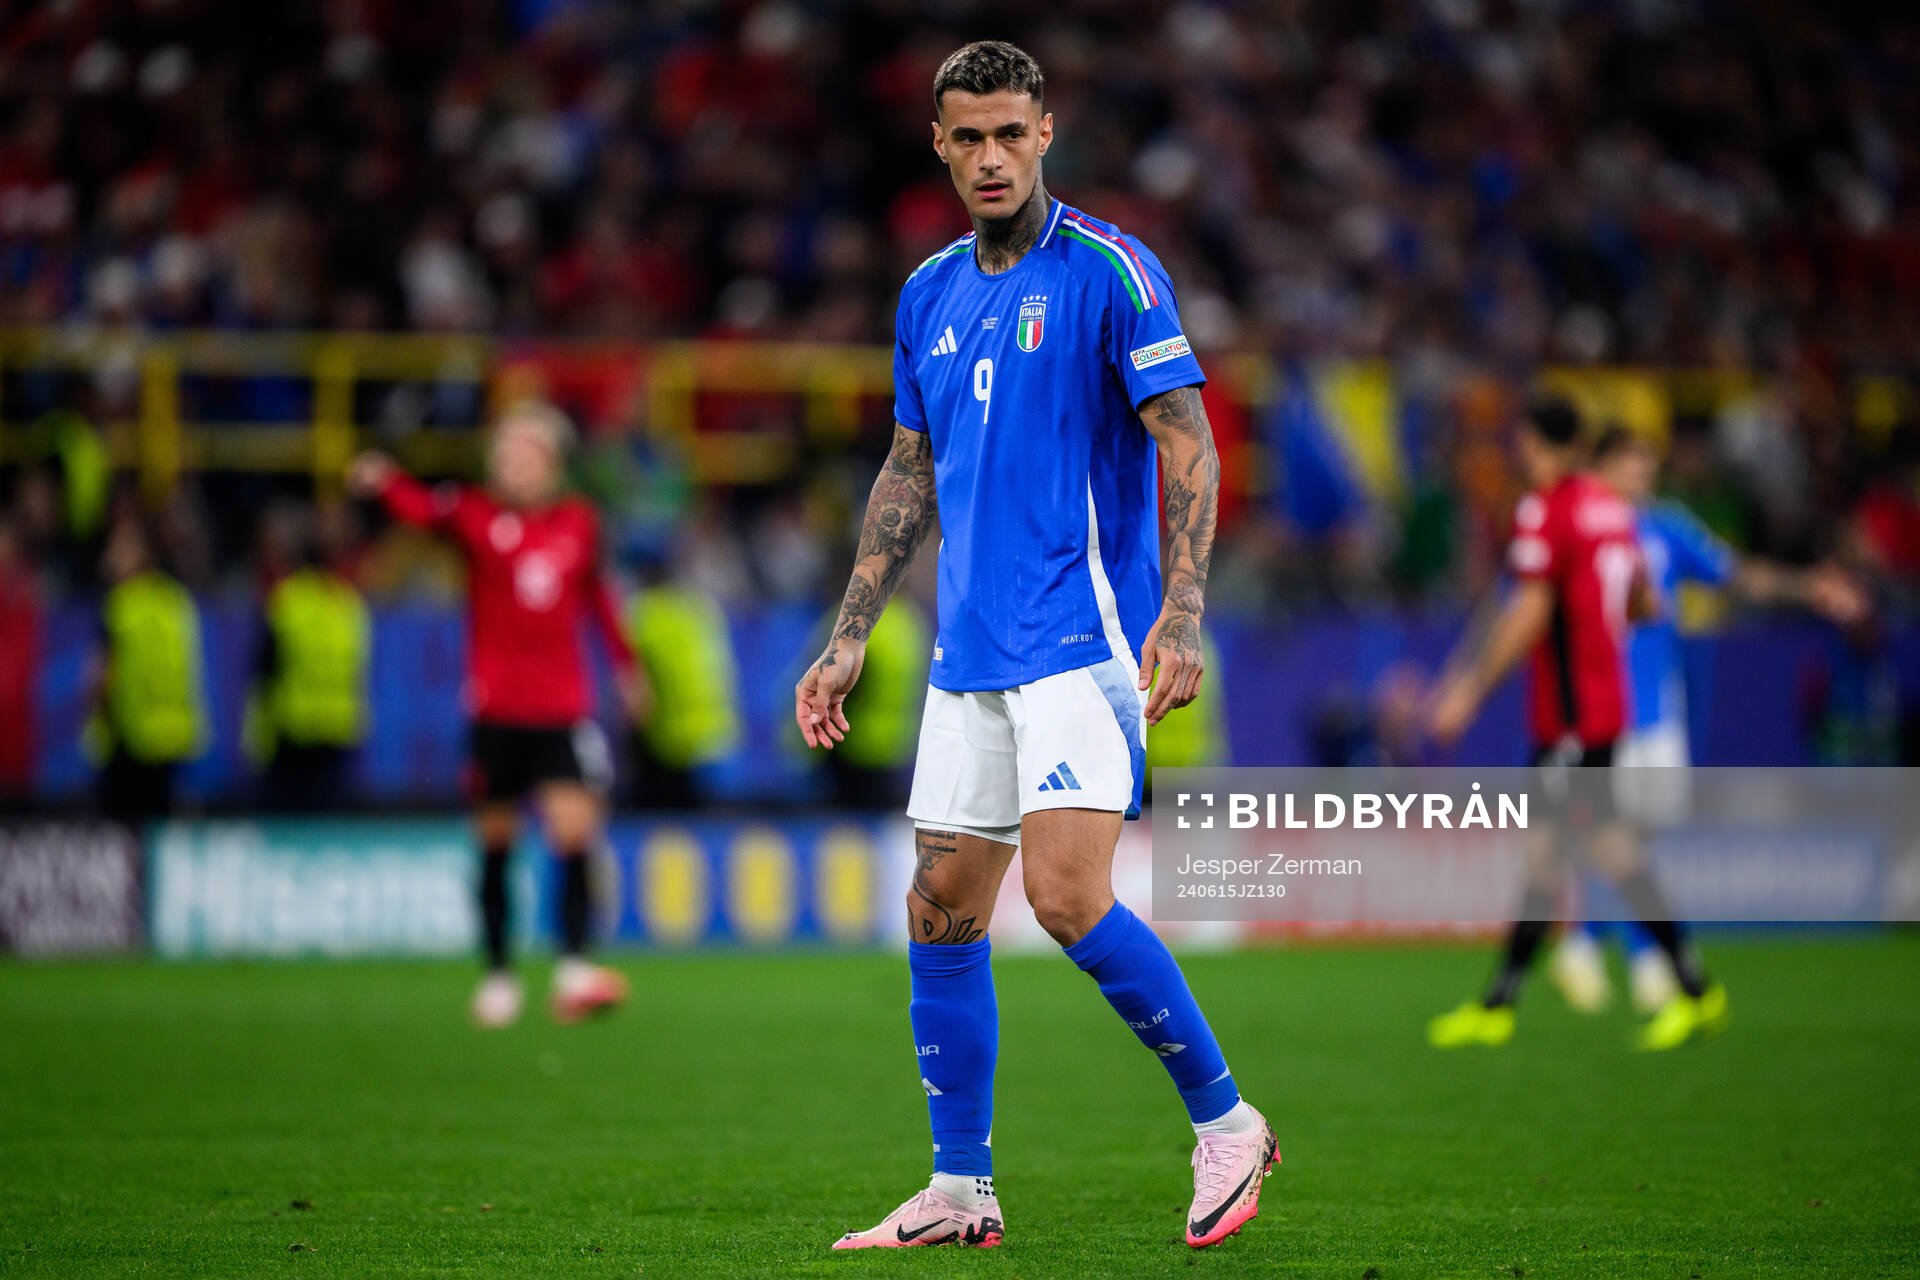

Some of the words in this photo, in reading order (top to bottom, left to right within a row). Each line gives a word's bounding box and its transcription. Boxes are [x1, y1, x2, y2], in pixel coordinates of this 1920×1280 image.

[1021, 307, 1043, 317] ITALIA
[1133, 341, 1187, 364] FOUNDATION
[974, 358, 994, 425] 9
